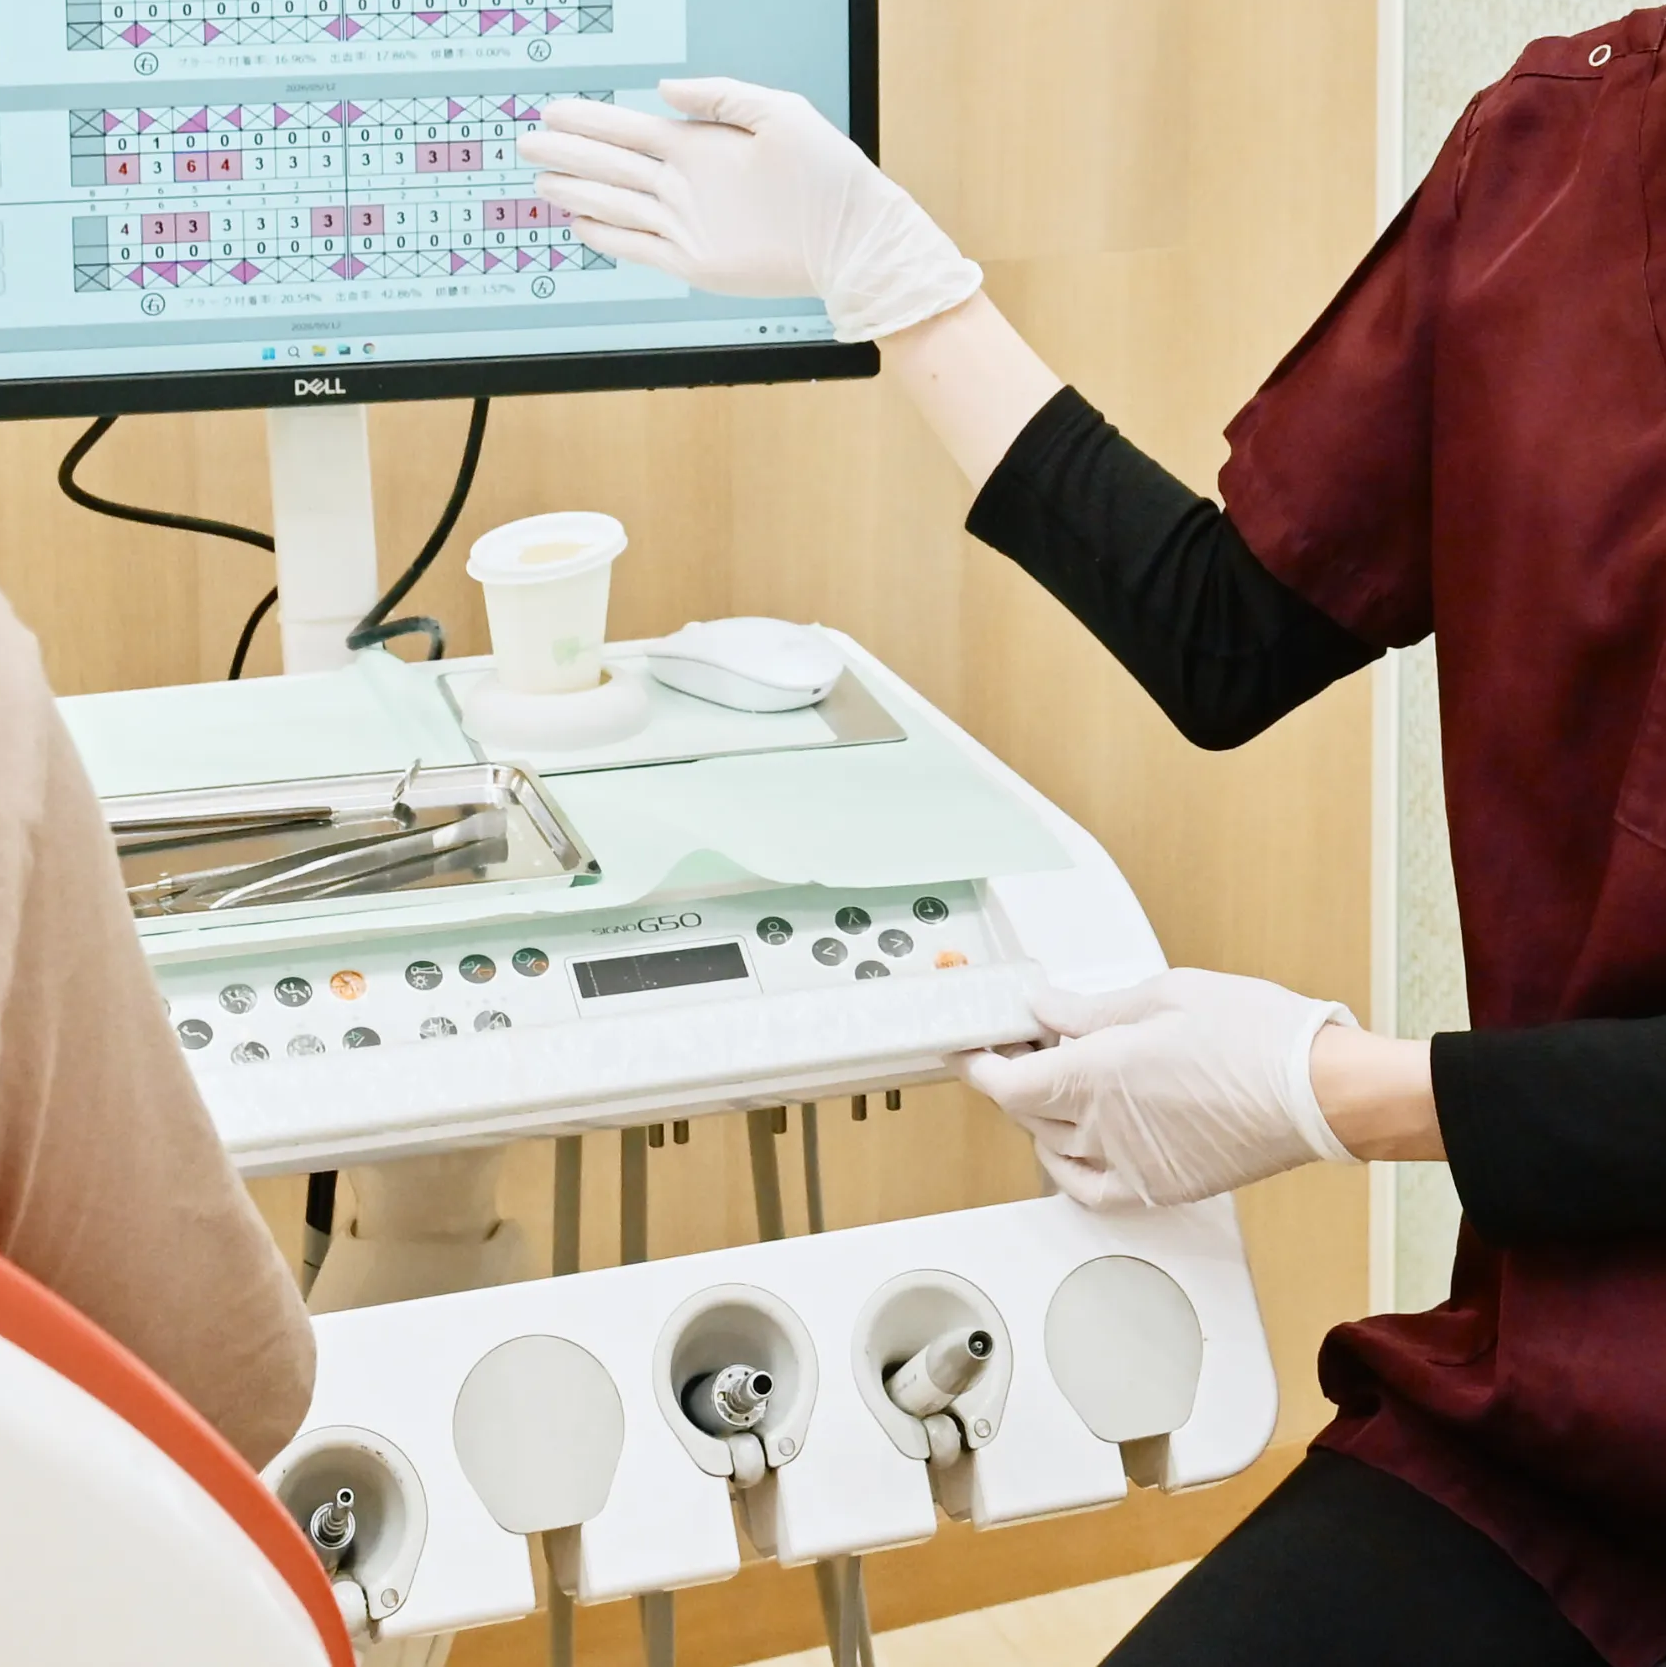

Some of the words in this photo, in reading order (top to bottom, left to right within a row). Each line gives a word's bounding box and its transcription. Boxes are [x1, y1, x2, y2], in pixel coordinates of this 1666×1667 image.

[114, 5, 124, 19] 0
[148, 4, 158, 18] 0
[182, 3, 192, 16] 0
[216, 1, 226, 15] 0
[250, 1, 260, 14] 0
[284, 0, 294, 14] 0
[318, 0, 328, 12] 0
[117, 137, 127, 151] 0
[186, 135, 196, 148] 0
[220, 134, 230, 147] 0
[253, 132, 264, 146] 0
[287, 131, 297, 145] 0
[321, 130, 331, 143] 0
[360, 128, 370, 142] 0
[394, 127, 404, 141] 0
[427, 126, 437, 139] 0
[461, 125, 470, 138] 0
[494, 123, 504, 137] 0
[118, 162, 128, 176] 4
[153, 160, 162, 175] 3
[186, 159, 197, 173] 6
[220, 158, 230, 172] 4
[255, 157, 264, 171] 3
[289, 155, 298, 169] 3
[322, 154, 332, 168] 3
[362, 153, 371, 166] 3
[395, 151, 404, 165] 3
[428, 150, 438, 164] 3
[461, 148, 471, 163] 3
[494, 148, 504, 160] 4
[120, 223, 129, 236] 4
[154, 221, 164, 235] 3
[188, 219, 198, 234] 3
[223, 218, 232, 232] 3
[257, 217, 266, 231] 3
[290, 215, 299, 229] 3
[324, 214, 333, 228] 3
[363, 212, 372, 227] 3
[396, 211, 406, 225] 3
[430, 209, 439, 223] 3
[463, 208, 472, 222] 3
[496, 206, 505, 221] 3
[528, 206, 538, 219] 4
[120, 247, 131, 261] 0
[155, 245, 165, 259] 0
[189, 244, 199, 257] 0
[222, 242, 232, 256] 0
[256, 241, 266, 255] 0
[290, 240, 300, 253] 0
[324, 238, 334, 252] 0
[363, 237, 373, 250] 0
[396, 236, 406, 249] 0
[429, 234, 439, 247] 0
[463, 232, 472, 246] 0
[495, 231, 505, 245] 0
[529, 230, 538, 243] 0
[561, 228, 571, 242] 0
[295, 378, 347, 396] DELL
[637, 912, 702, 933] G50
